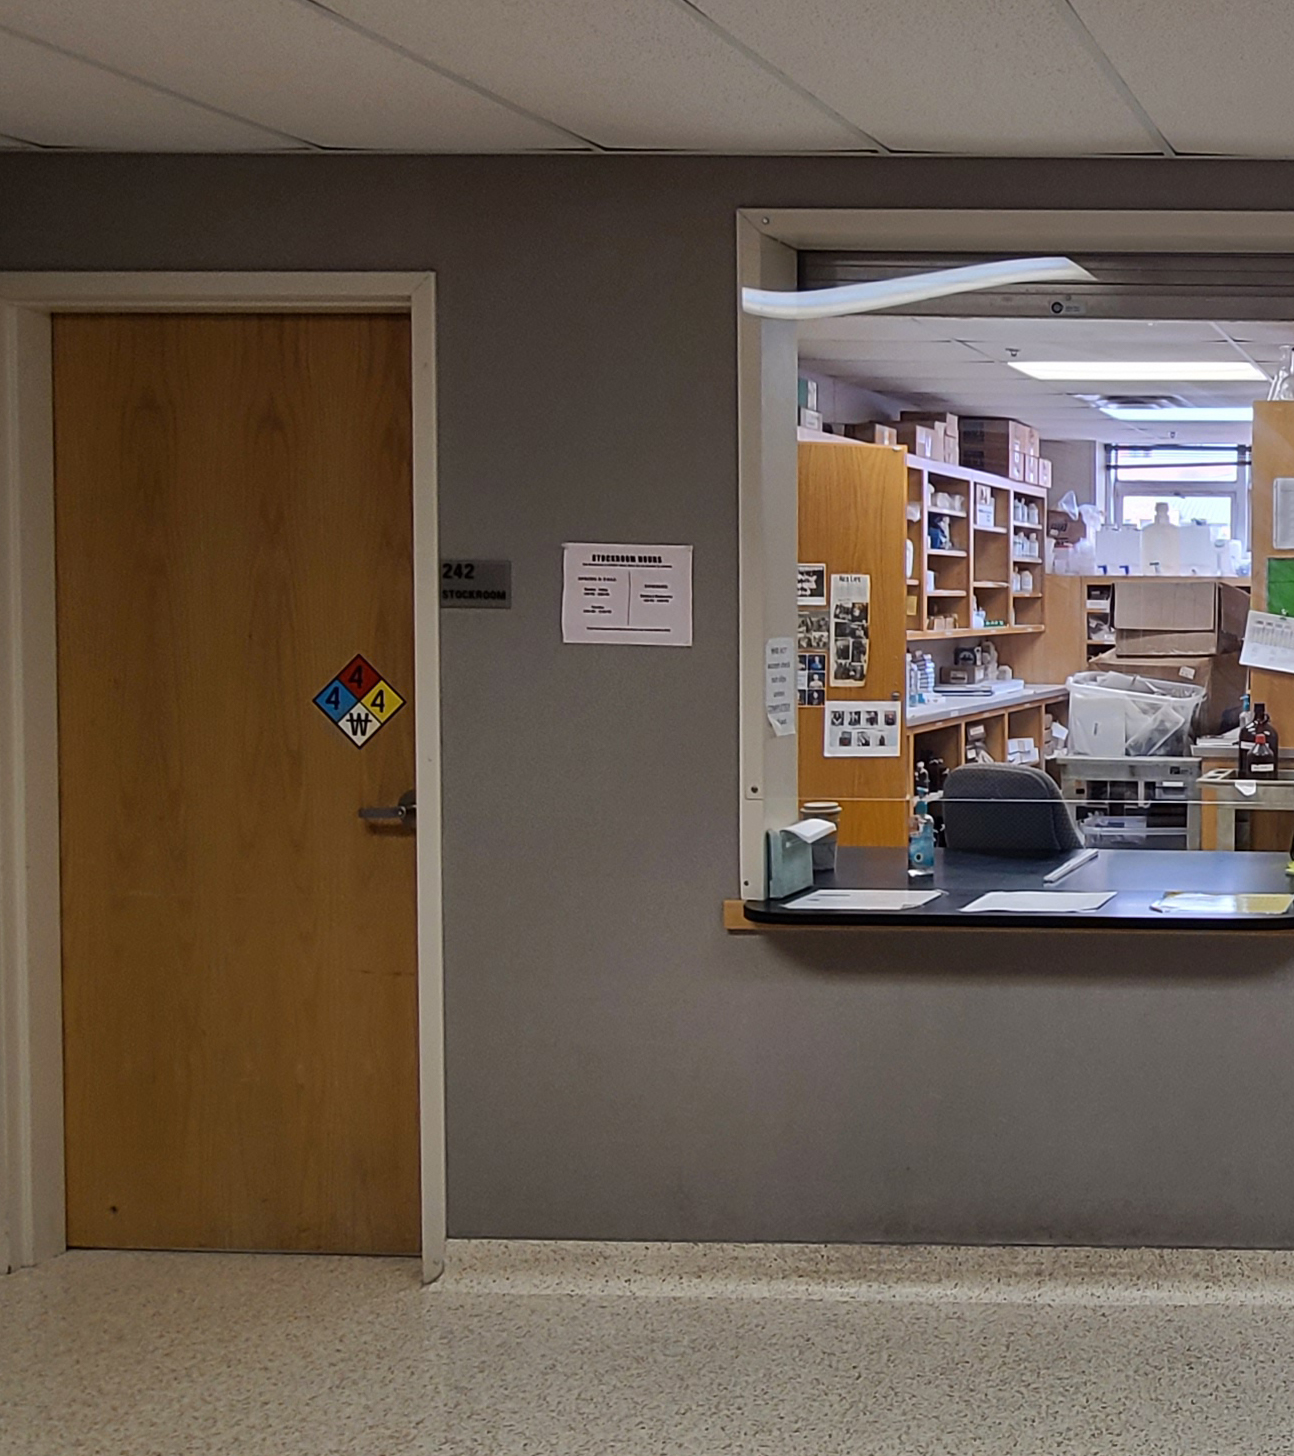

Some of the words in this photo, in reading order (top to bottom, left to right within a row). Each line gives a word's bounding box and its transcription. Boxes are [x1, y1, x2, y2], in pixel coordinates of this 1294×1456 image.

[592, 554, 636, 562] STOCKROOM
[442, 563, 474, 579] 242
[442, 590, 506, 600] STOCKROOM
[348, 665, 363, 688] 4
[325, 686, 341, 710] 4
[370, 689, 385, 713] 4
